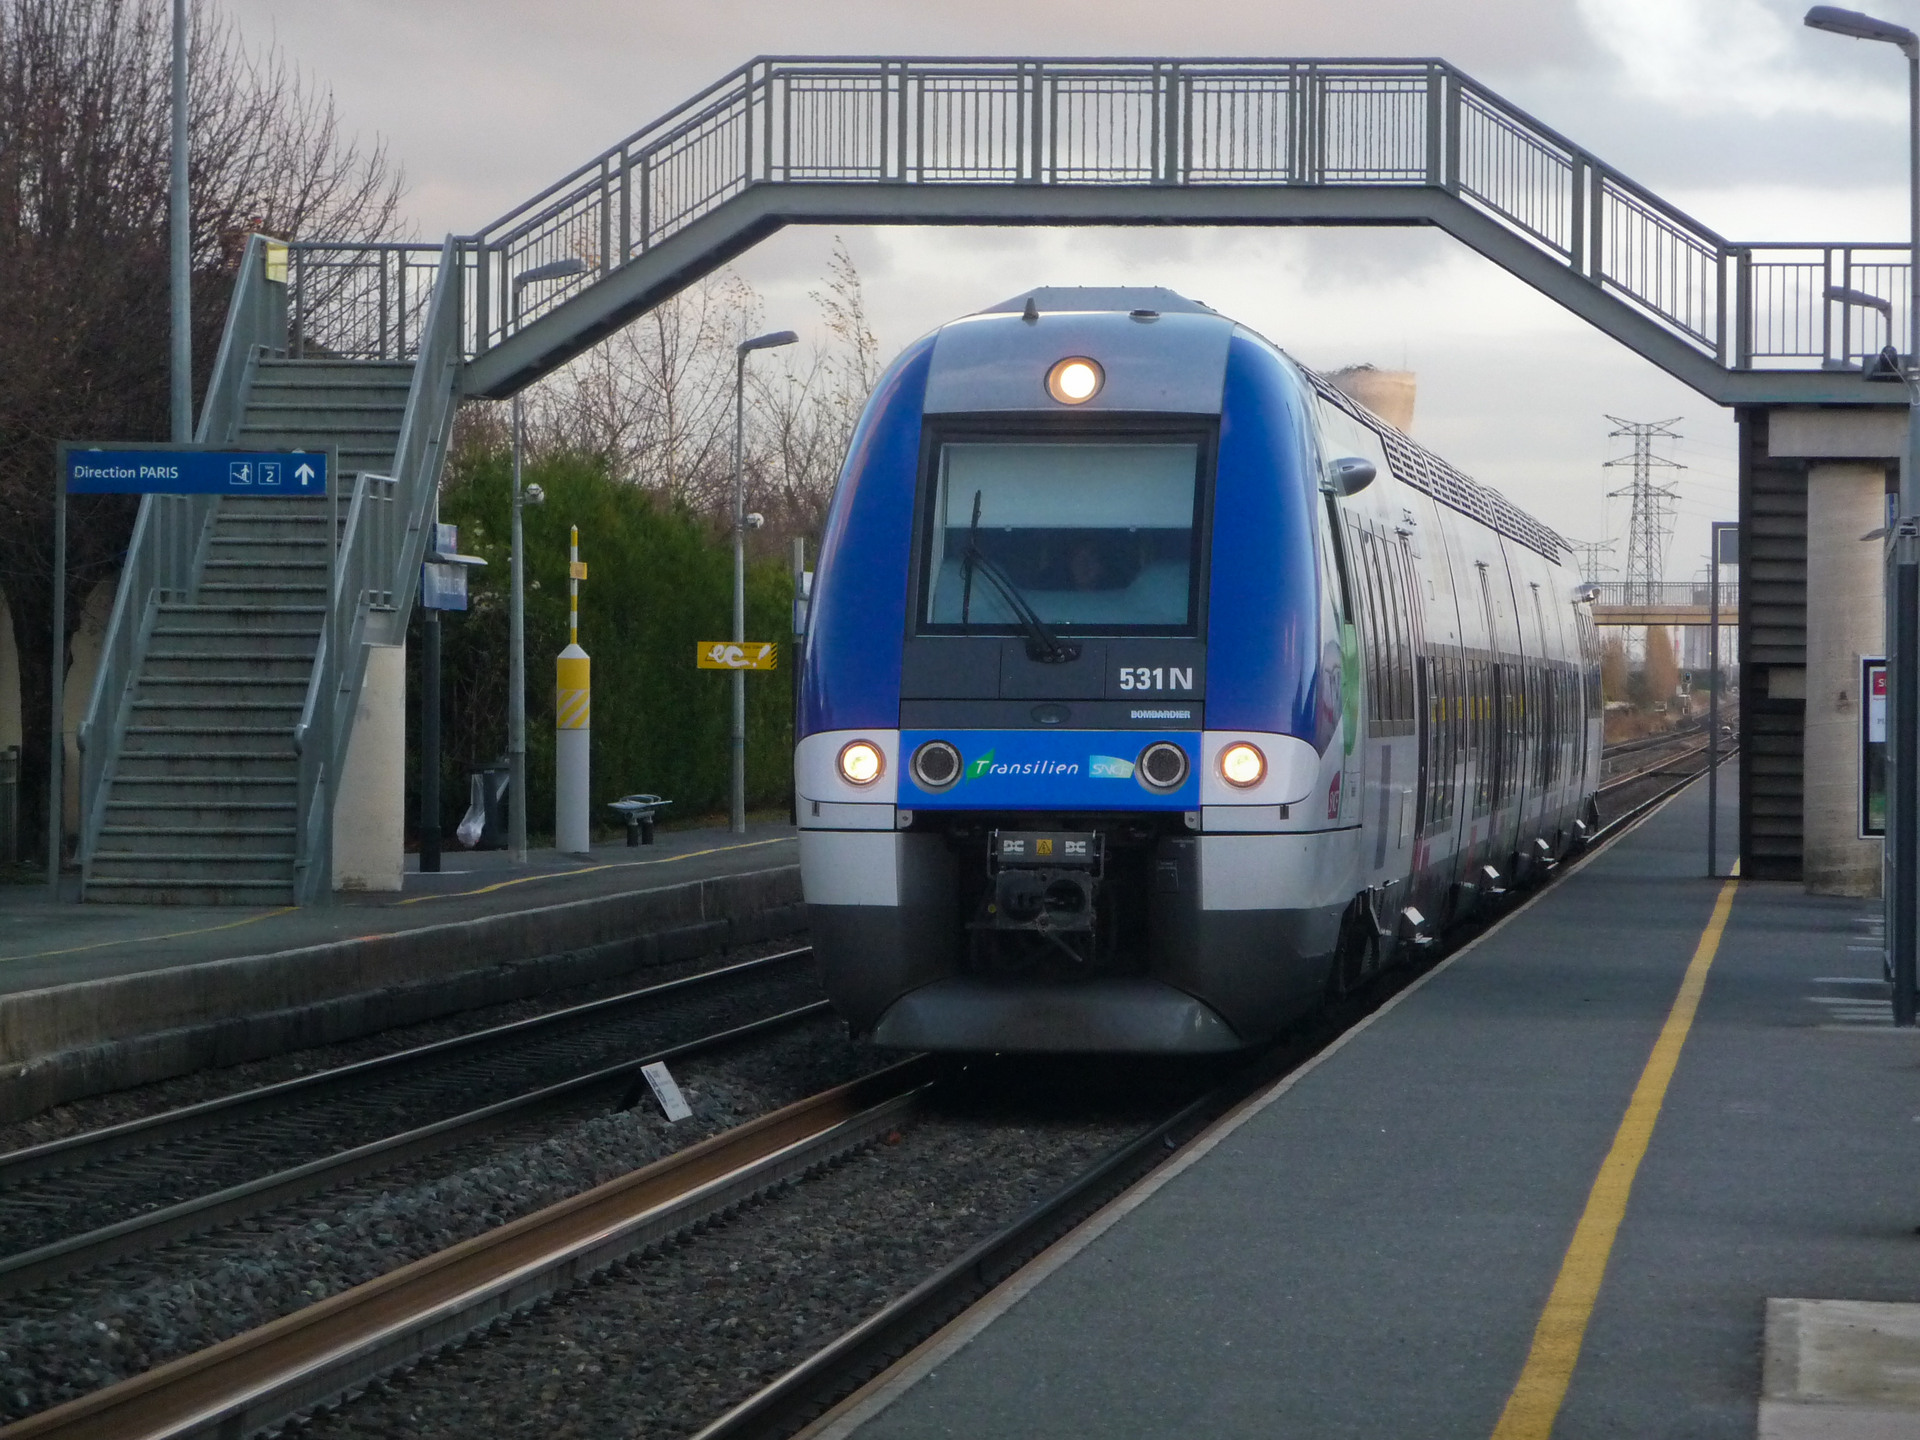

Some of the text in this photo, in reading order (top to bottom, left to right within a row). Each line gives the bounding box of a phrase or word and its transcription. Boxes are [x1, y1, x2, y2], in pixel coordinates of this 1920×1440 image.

[74, 465, 179, 479] Direction PARIS
[266, 471, 274, 482] 2
[1130, 710, 1191, 719] BOMBARDIER
[976, 760, 1079, 775] Transilien
[1090, 763, 1130, 776] SNCF
